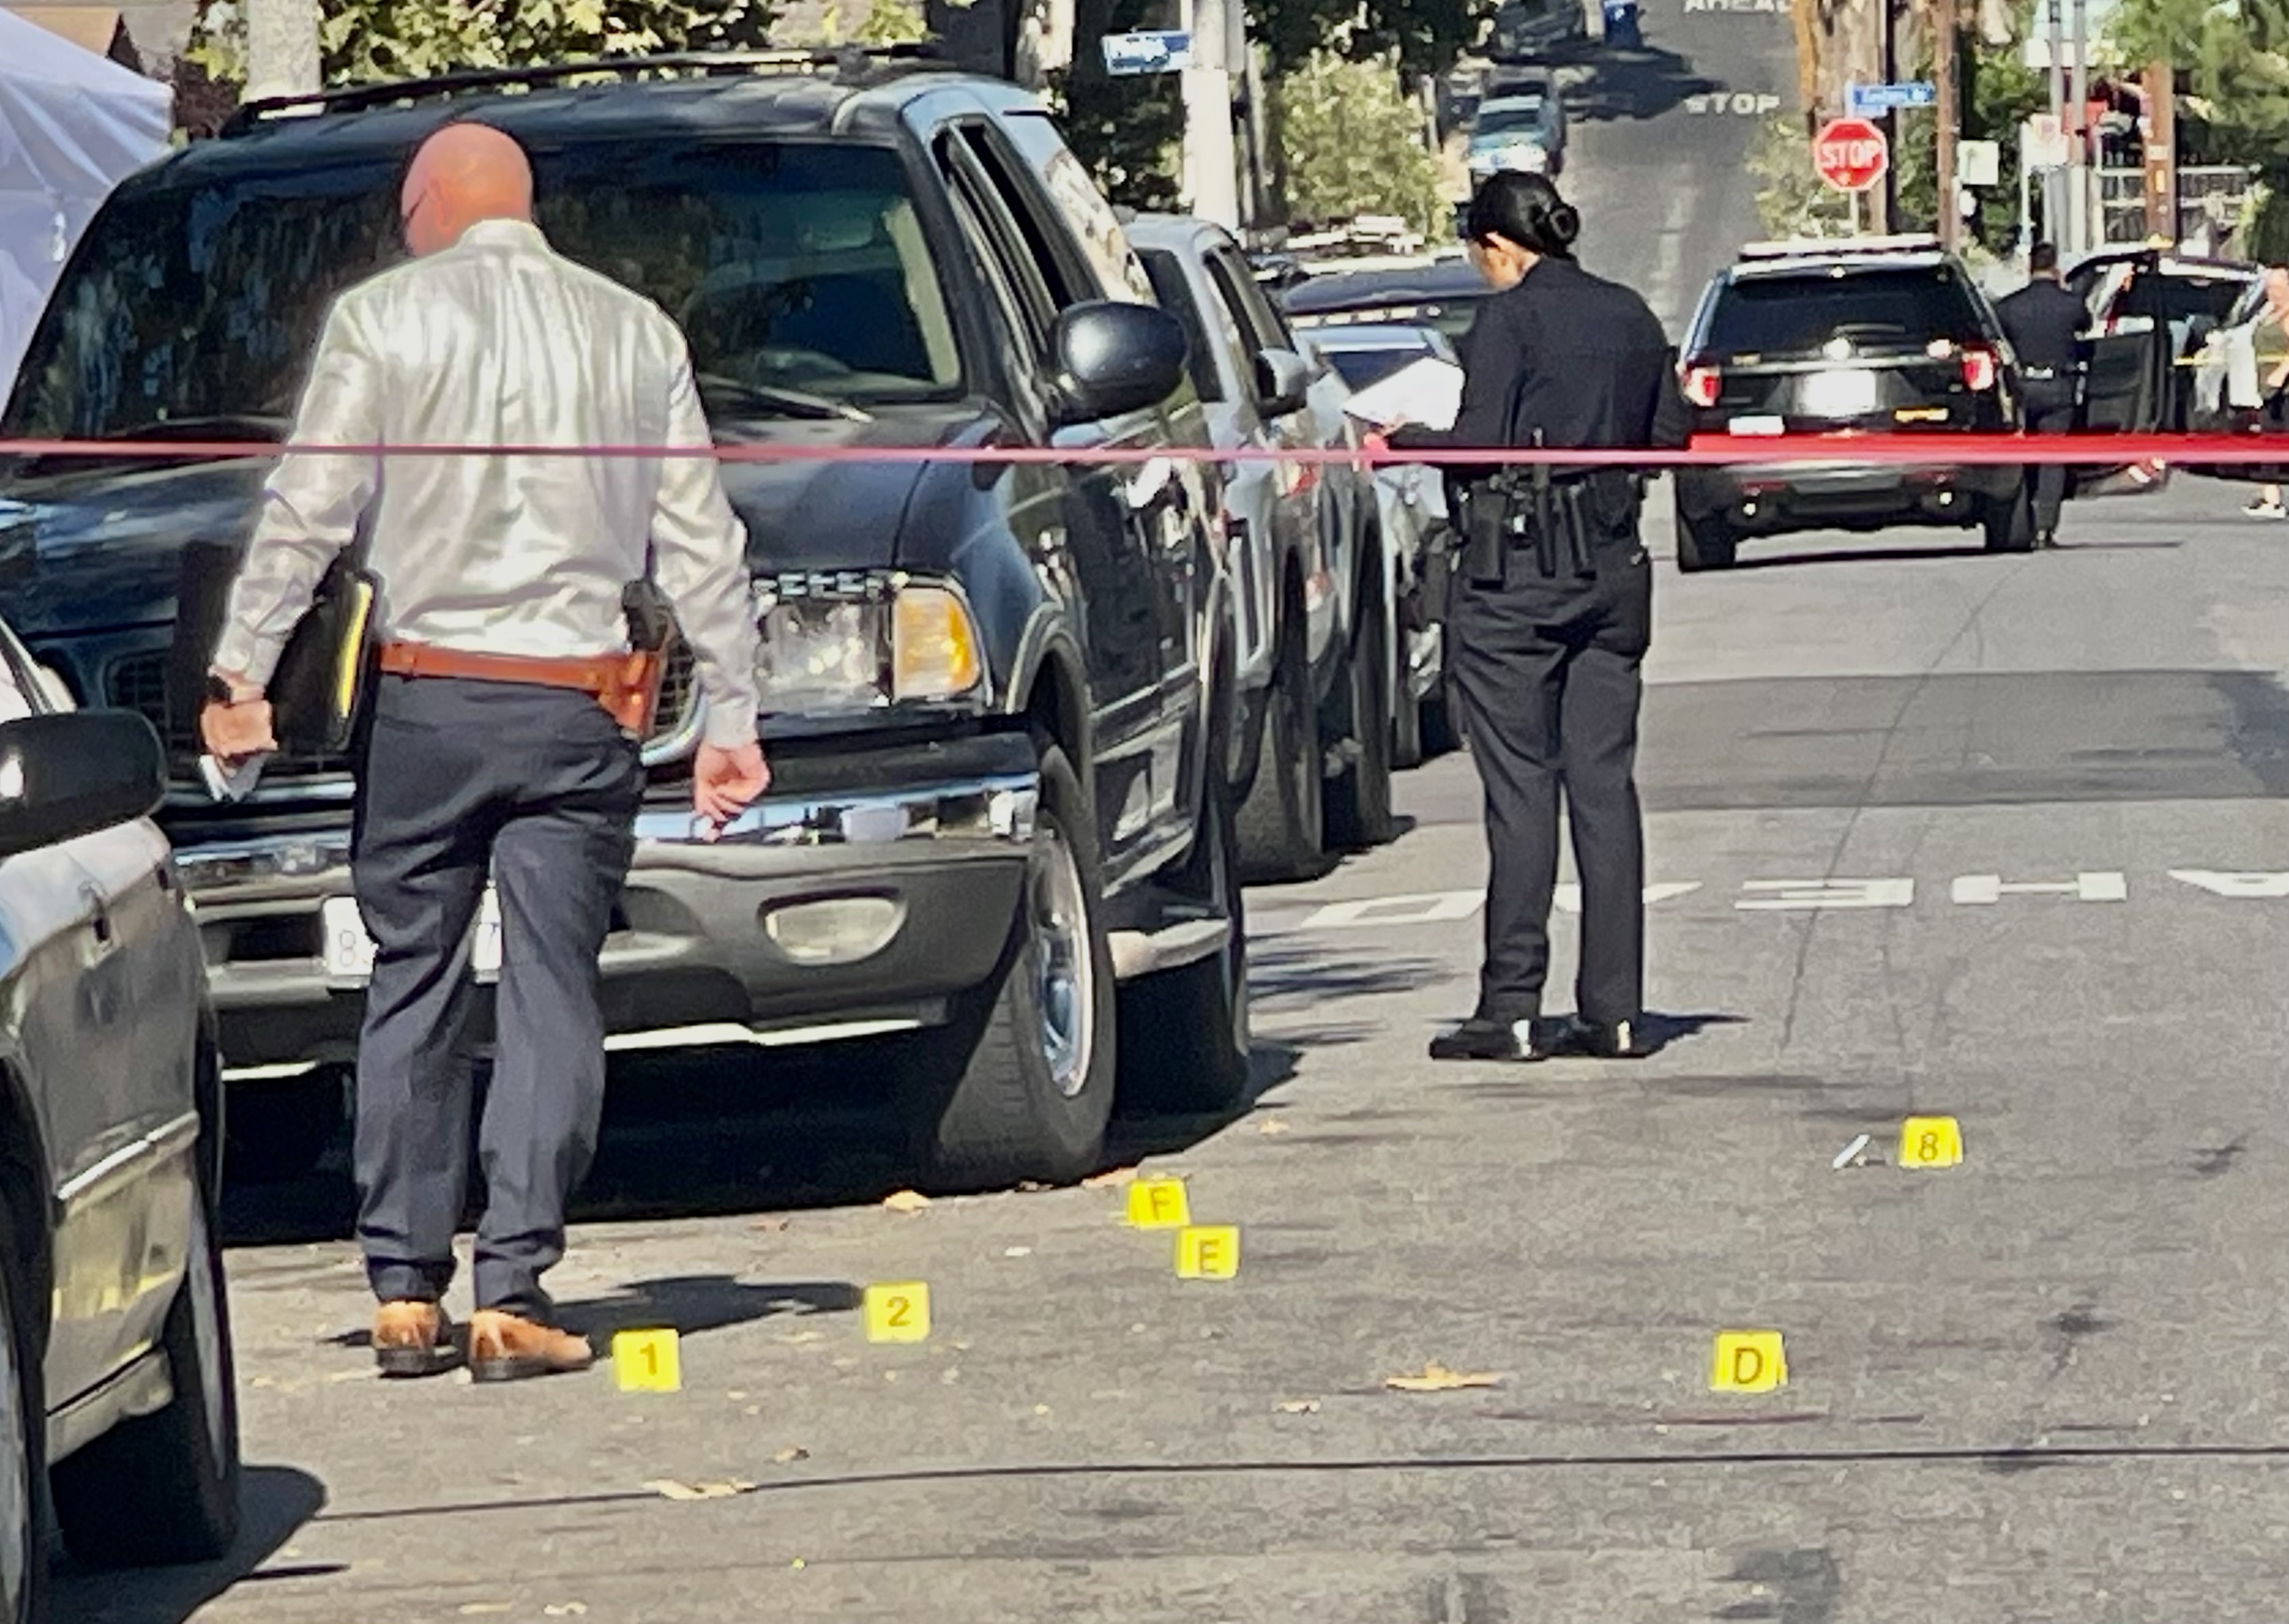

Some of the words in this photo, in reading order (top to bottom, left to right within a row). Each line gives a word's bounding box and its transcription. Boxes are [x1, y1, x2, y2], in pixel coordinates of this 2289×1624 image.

[1684, 93, 1780, 114] STOP
[1821, 140, 1881, 169] STOP
[1918, 1132, 1938, 1162] 8
[1148, 1187, 1170, 1221] F
[1199, 1238, 1220, 1274] E
[886, 1296, 911, 1327] 2
[639, 1342, 659, 1376] 1
[1732, 1346, 1763, 1385] D
